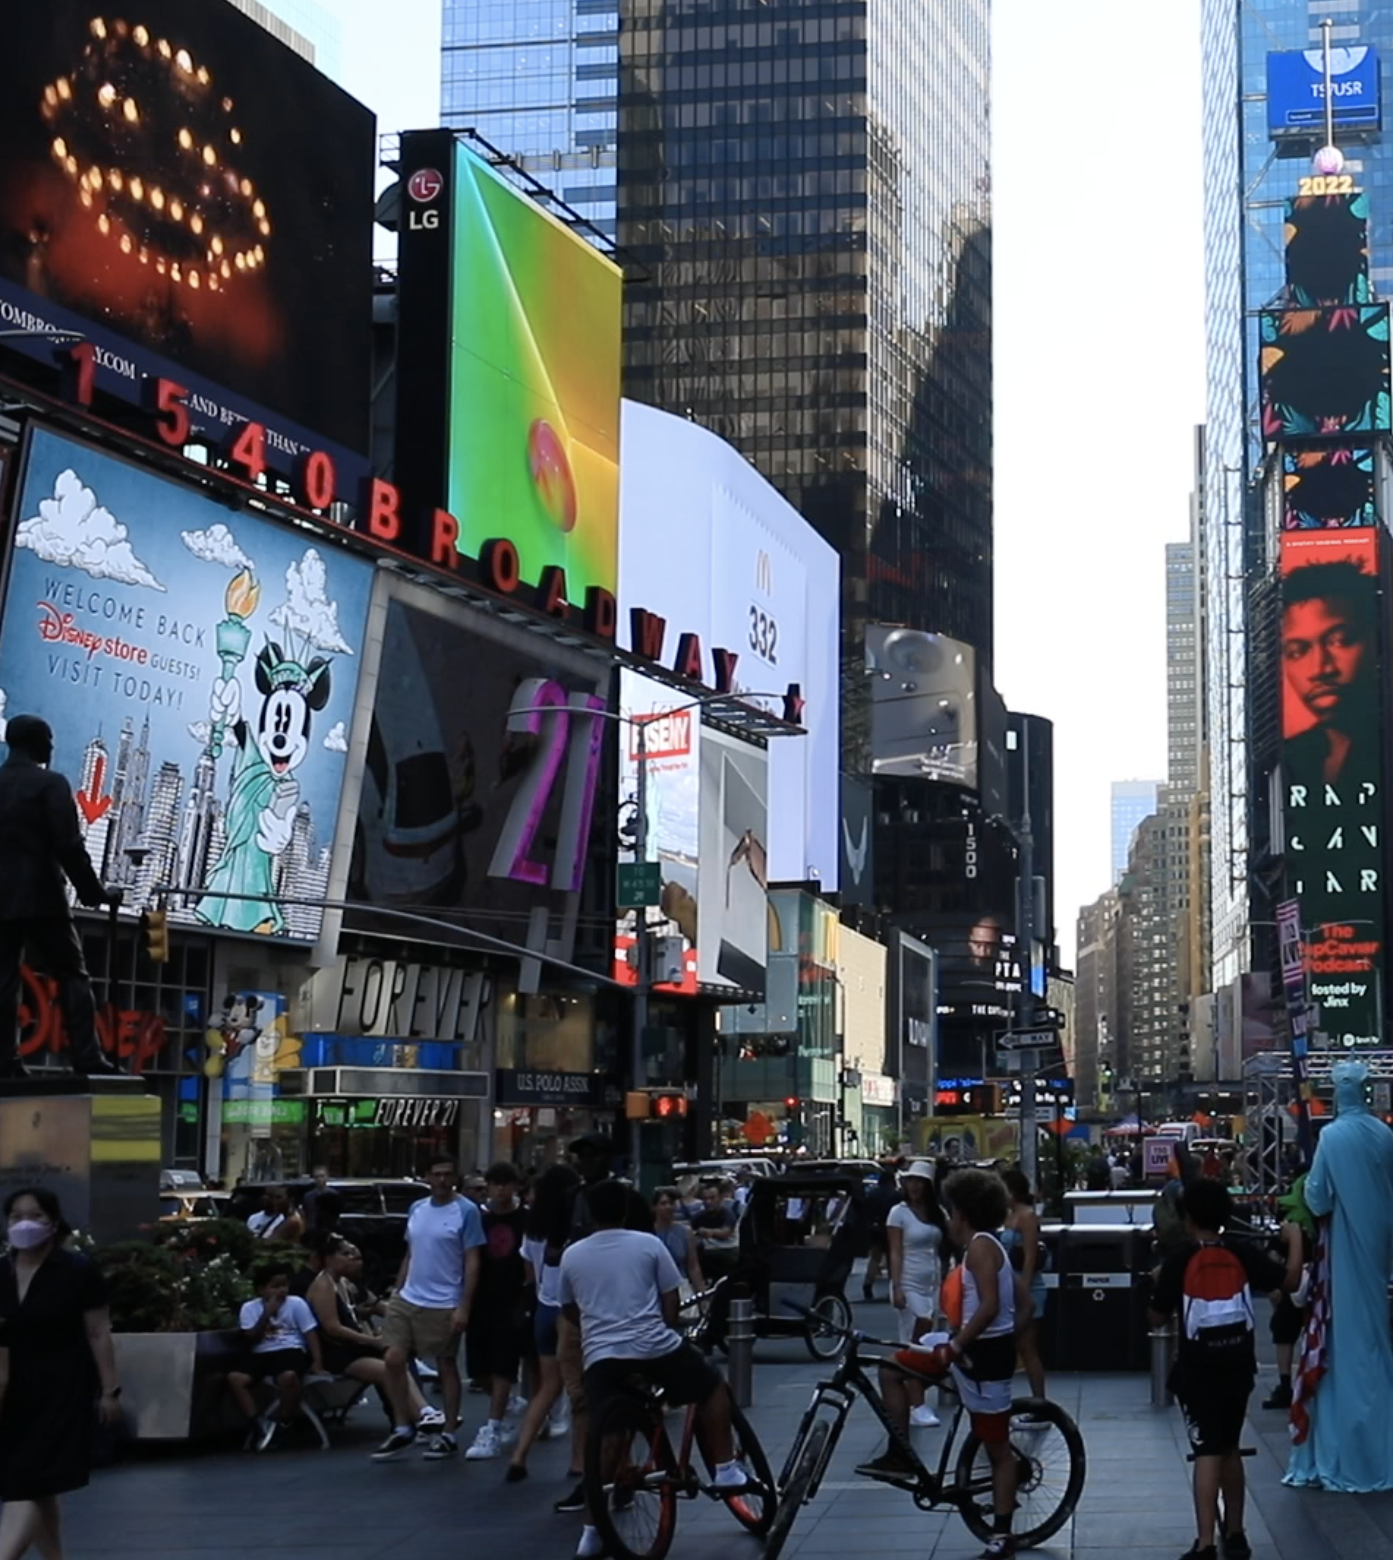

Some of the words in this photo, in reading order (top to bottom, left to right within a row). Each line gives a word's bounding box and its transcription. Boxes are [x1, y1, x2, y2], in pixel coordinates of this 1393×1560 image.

[1299, 175, 1352, 196] 2022
[409, 208, 440, 230] LG
[190, 393, 218, 418] AND
[366, 477, 740, 695] BROADWAY
[44, 577, 146, 630] WELCOME
[156, 614, 207, 649] BACK
[747, 604, 778, 665] 332
[103, 633, 148, 665] store
[150, 654, 200, 682] GUESTS!
[49, 653, 103, 689] VISIT
[113, 671, 183, 711] TODAY!
[964, 822, 978, 878] 1500
[336, 955, 492, 1041] FOREVER
[1350, 983, 1367, 998] by
[1031, 1033, 1050, 1042] WAY
[535, 1074, 562, 1092] POLO
[374, 1098, 441, 1127] FOREVER
[441, 1099, 459, 1127] 21
